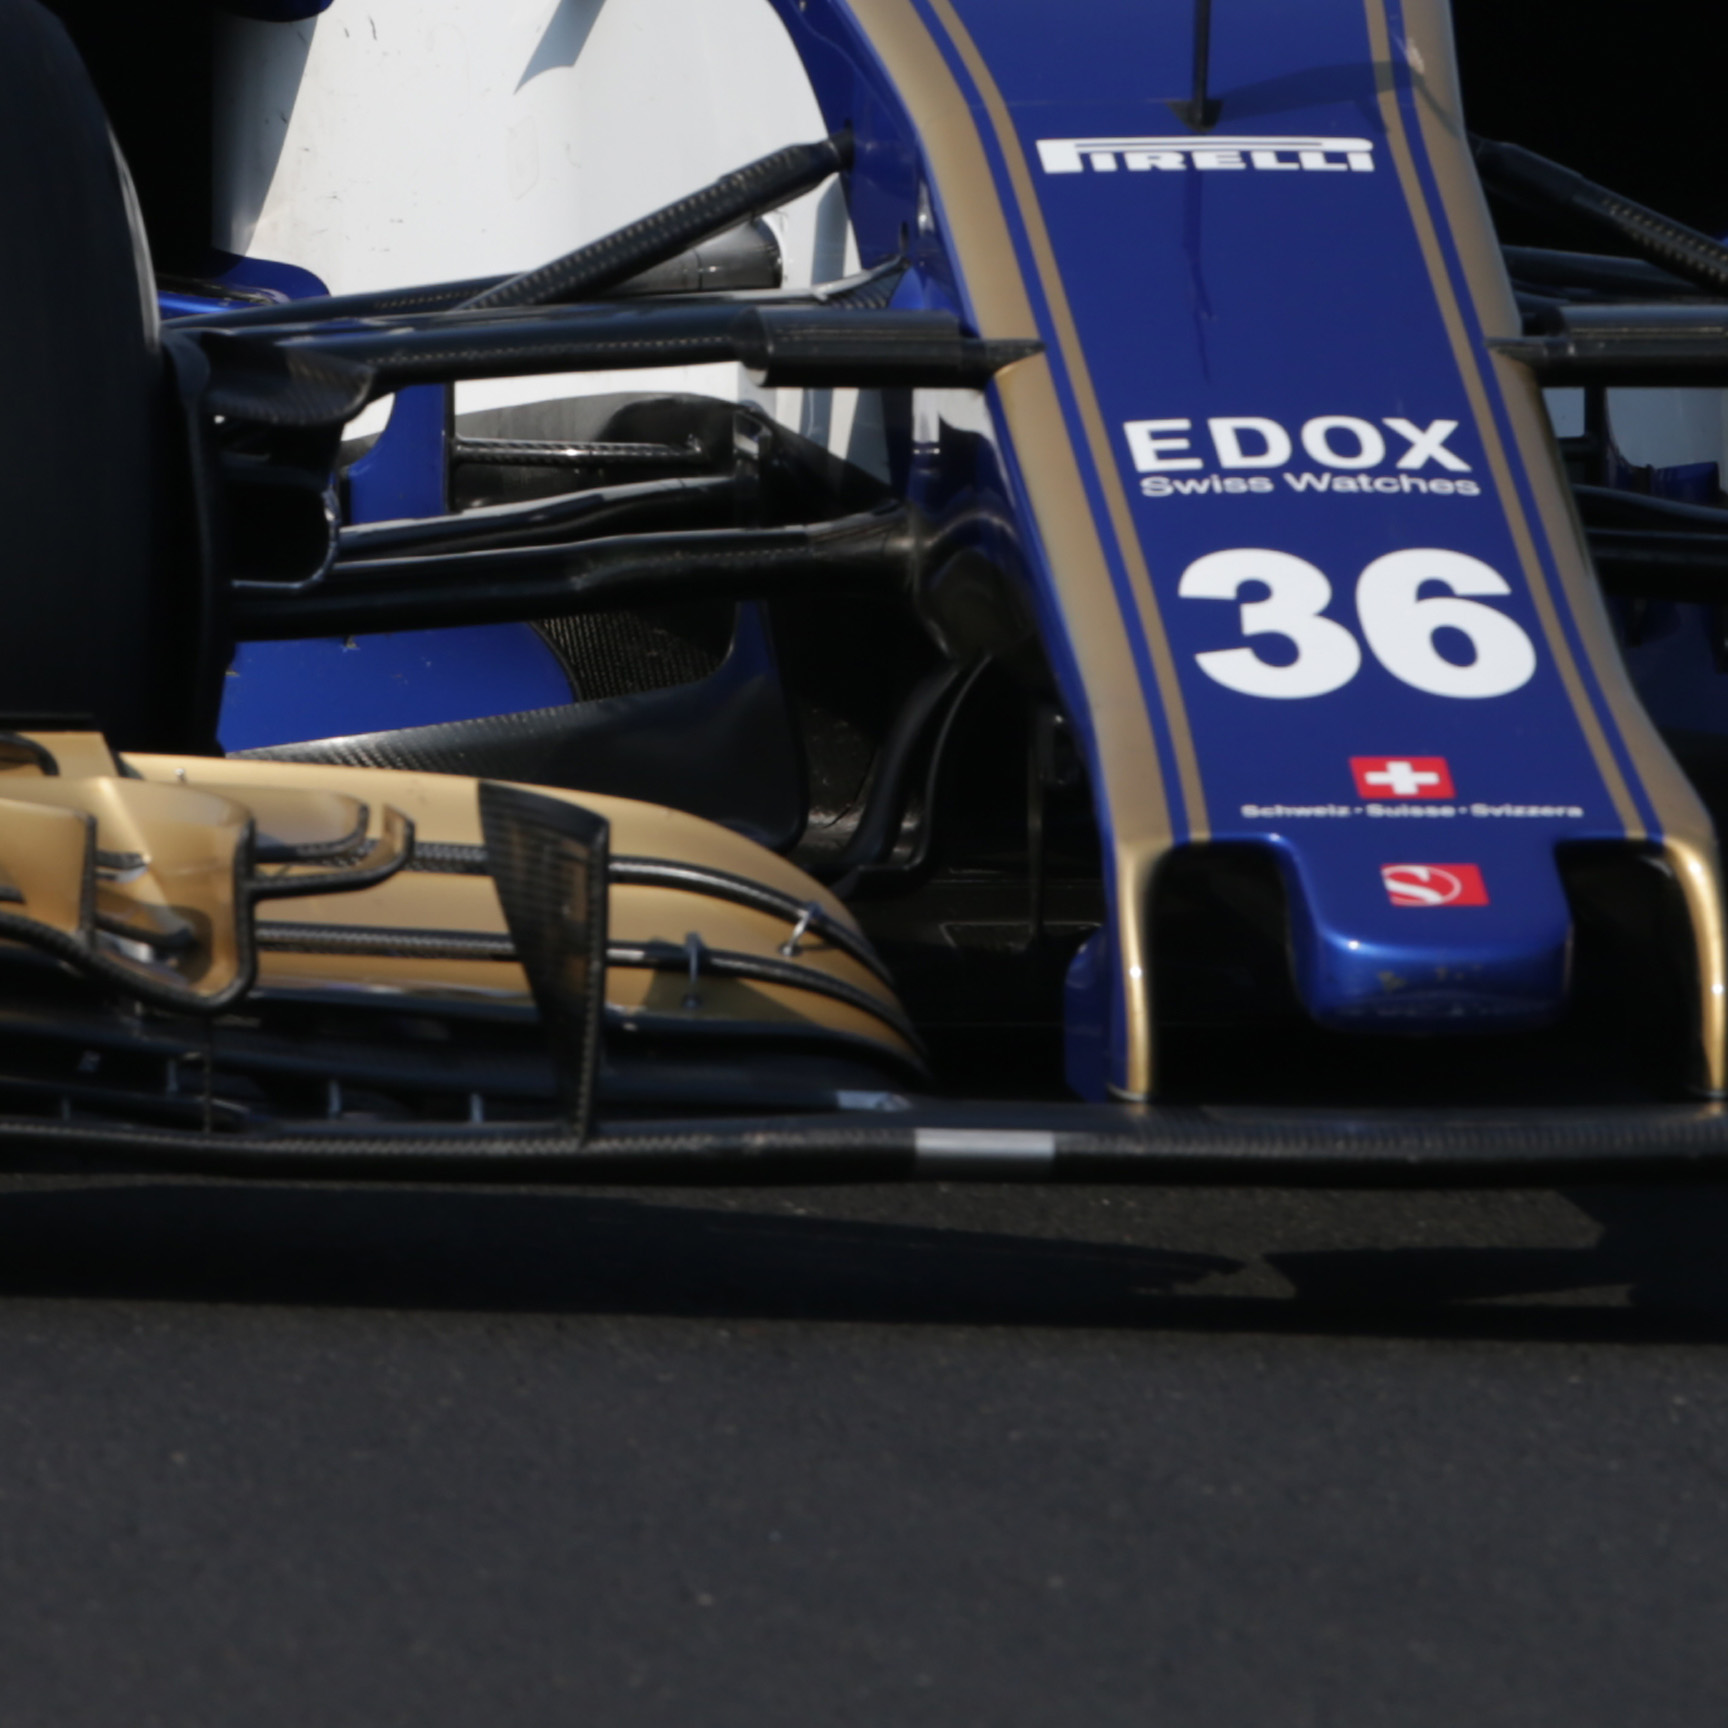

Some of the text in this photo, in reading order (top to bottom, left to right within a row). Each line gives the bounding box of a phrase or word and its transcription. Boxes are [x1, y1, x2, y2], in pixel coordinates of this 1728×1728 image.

[1035, 134, 1376, 175] PIRELLI
[1122, 415, 1473, 473] EDOX
[1139, 471, 1483, 498] Swiss Watches
[1178, 547, 1537, 700] 36
